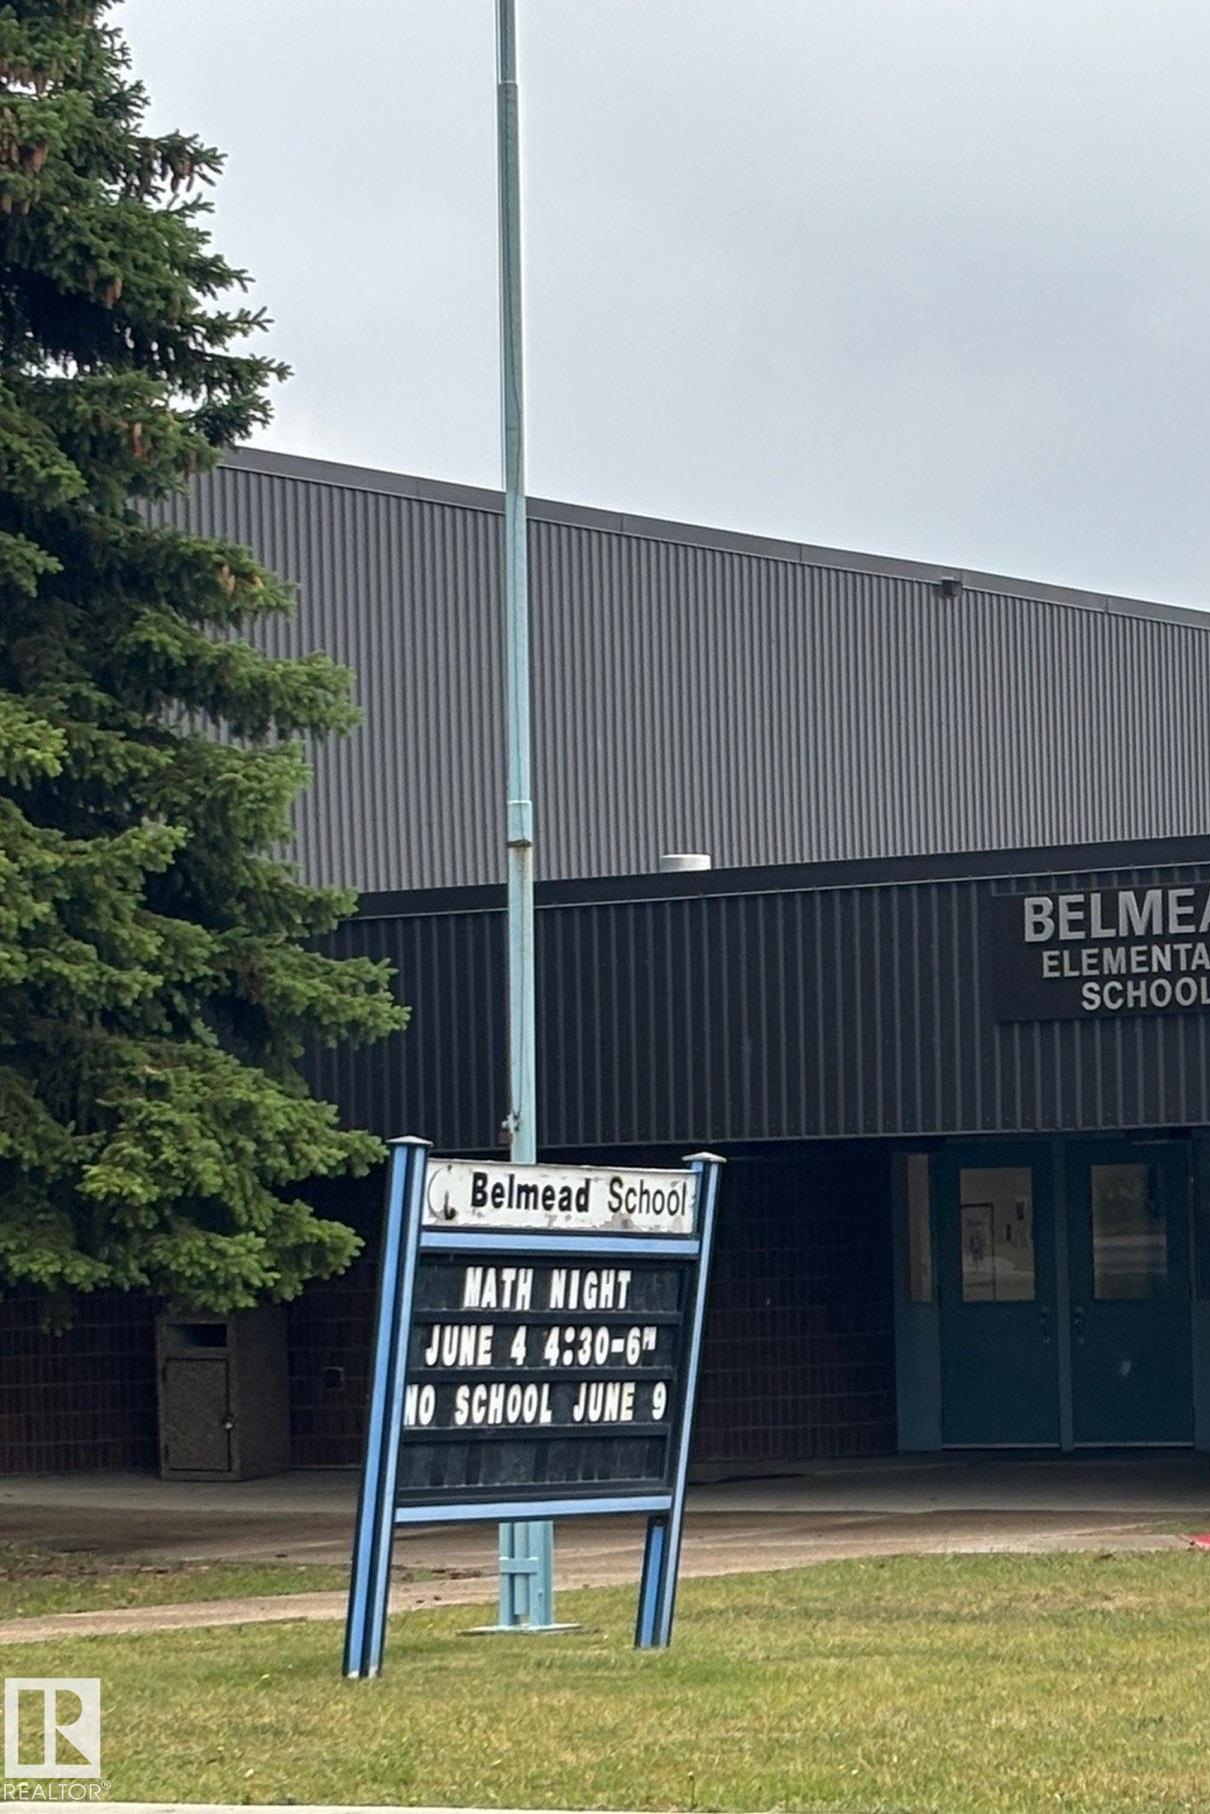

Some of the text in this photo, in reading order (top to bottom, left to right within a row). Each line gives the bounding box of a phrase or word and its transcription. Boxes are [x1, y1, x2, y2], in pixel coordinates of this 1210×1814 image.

[470, 1171, 688, 1216] Belmead School
[463, 1266, 632, 1311] MATH NIGHT
[425, 1324, 494, 1366] JUNE
[510, 1326, 527, 1365] 4
[403, 1381, 668, 1426] NO SCHOOL JUNE 9
